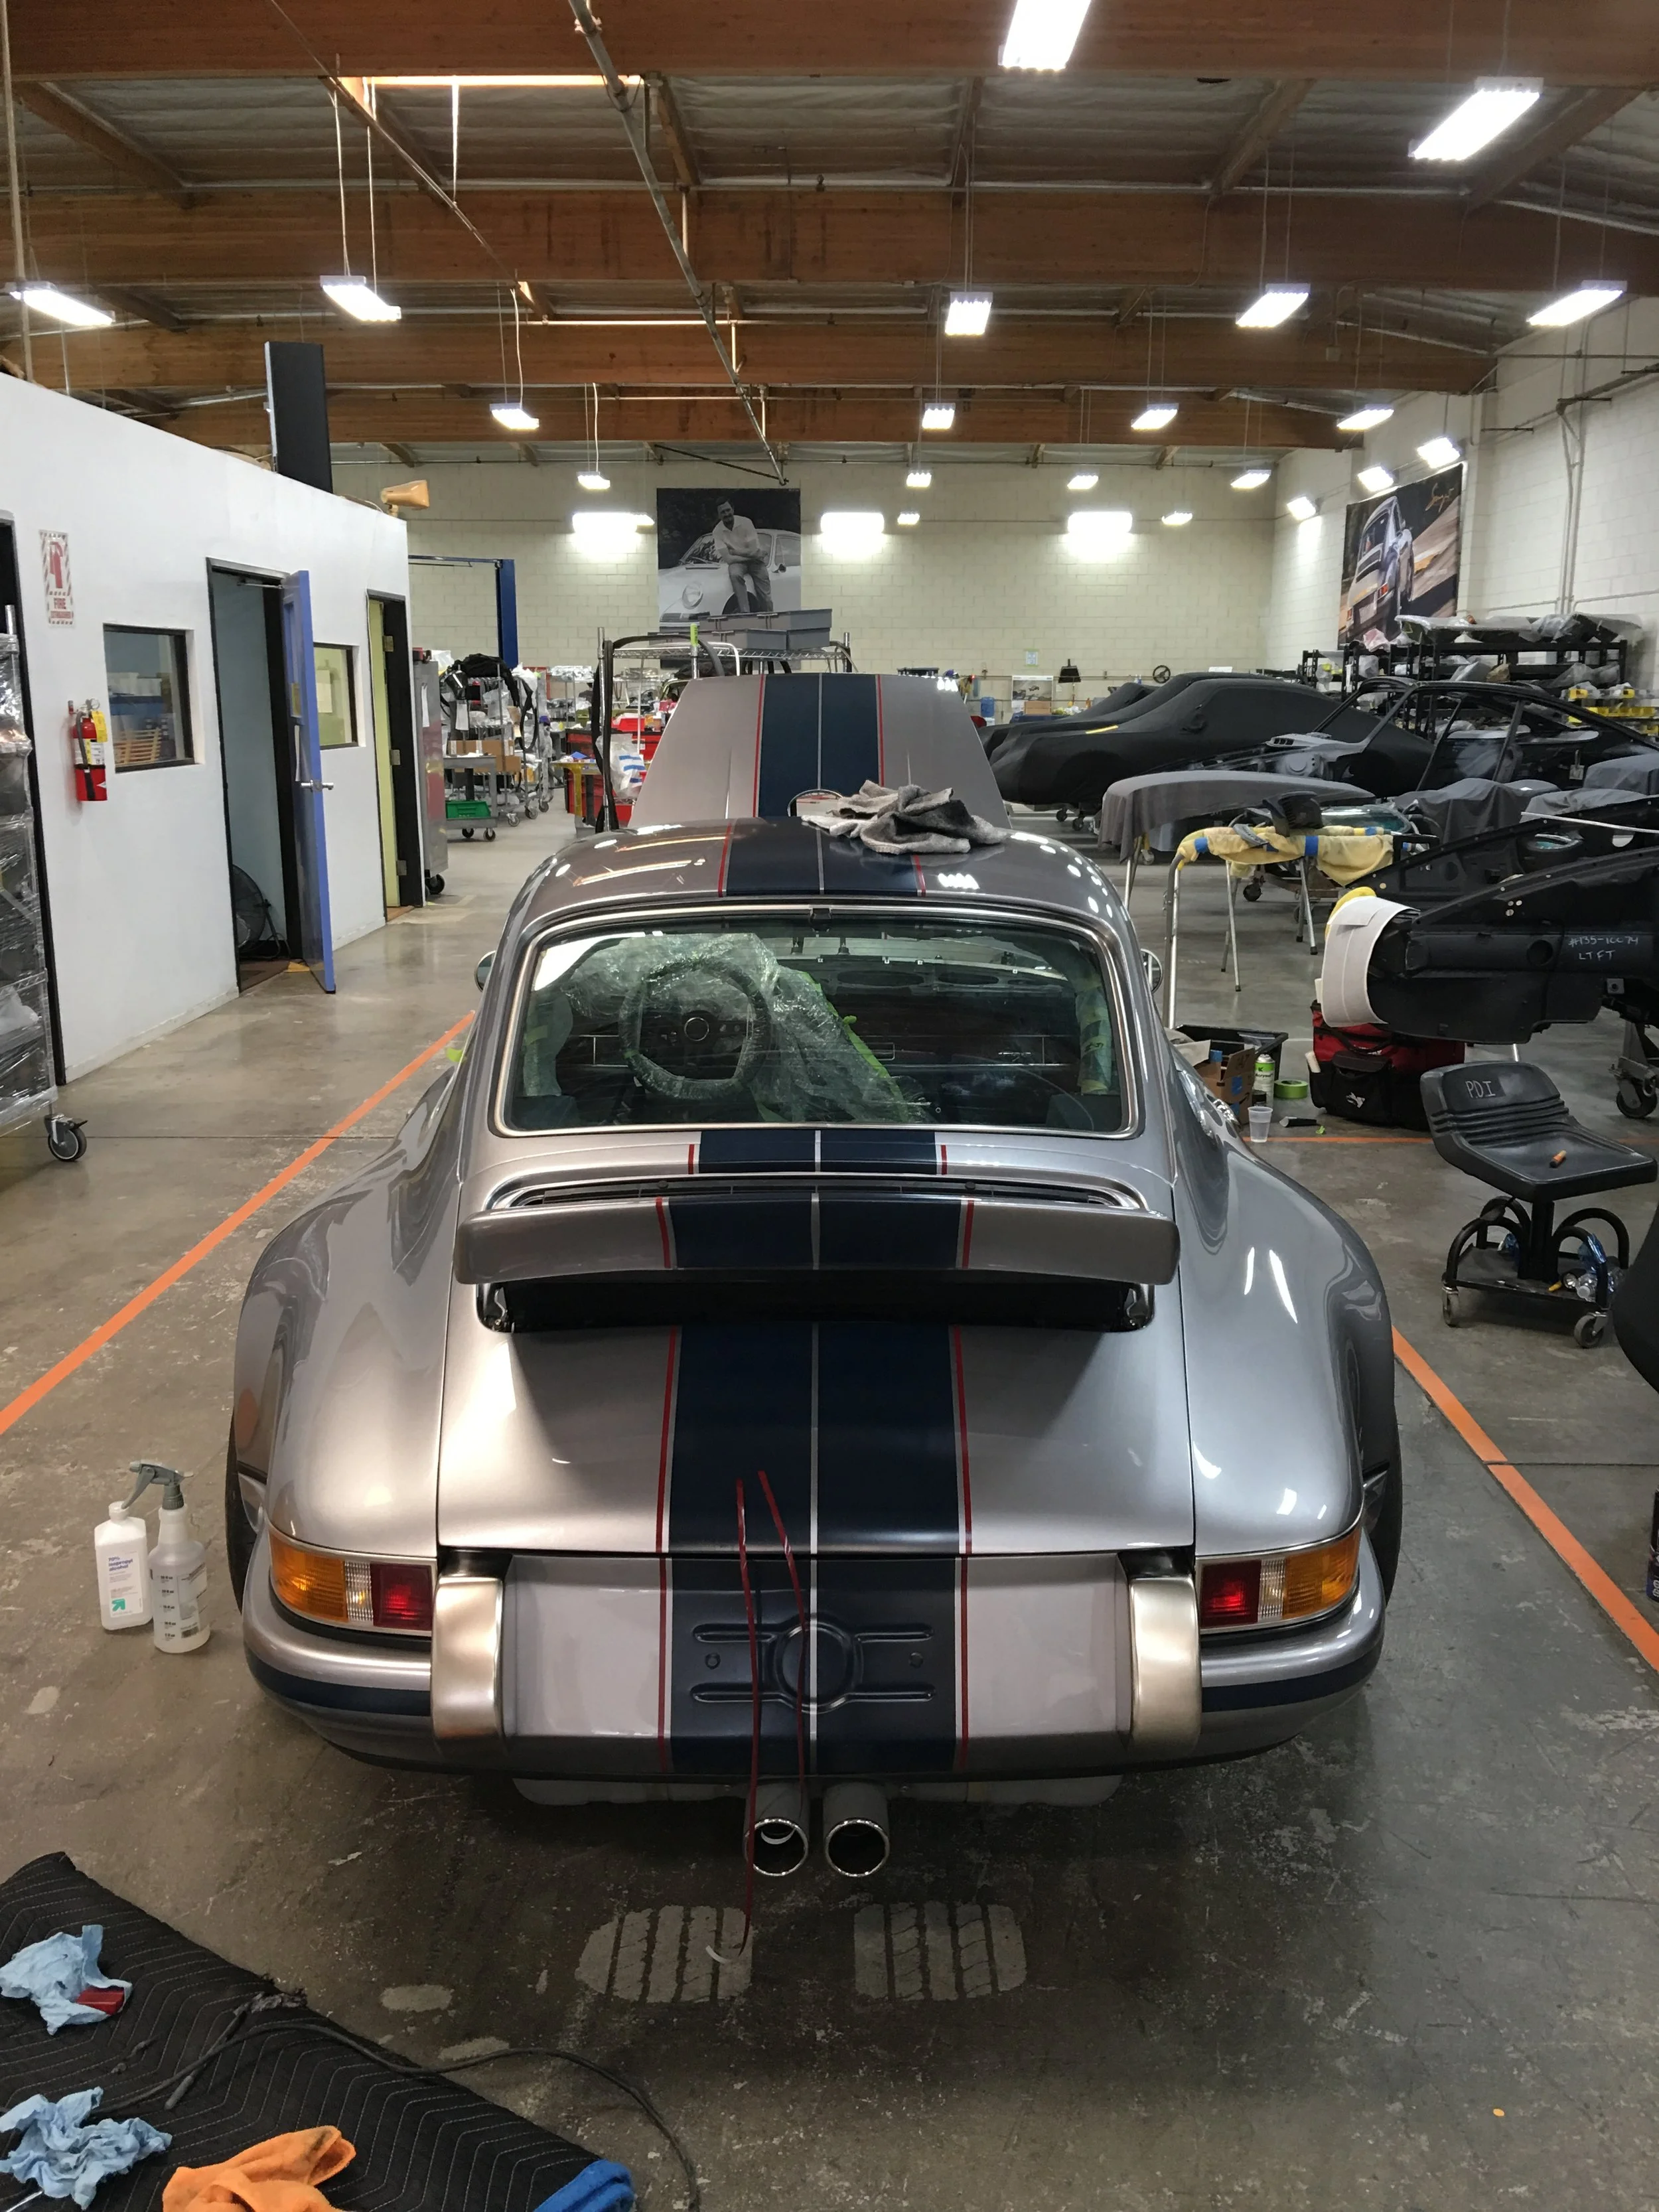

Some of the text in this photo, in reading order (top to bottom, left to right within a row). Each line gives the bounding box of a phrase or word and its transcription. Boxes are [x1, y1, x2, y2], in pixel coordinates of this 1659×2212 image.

[54, 598, 66, 609] FIRE
[1465, 1080, 1496, 1098] PDI
[108, 1558, 133, 1567] isopropyl
